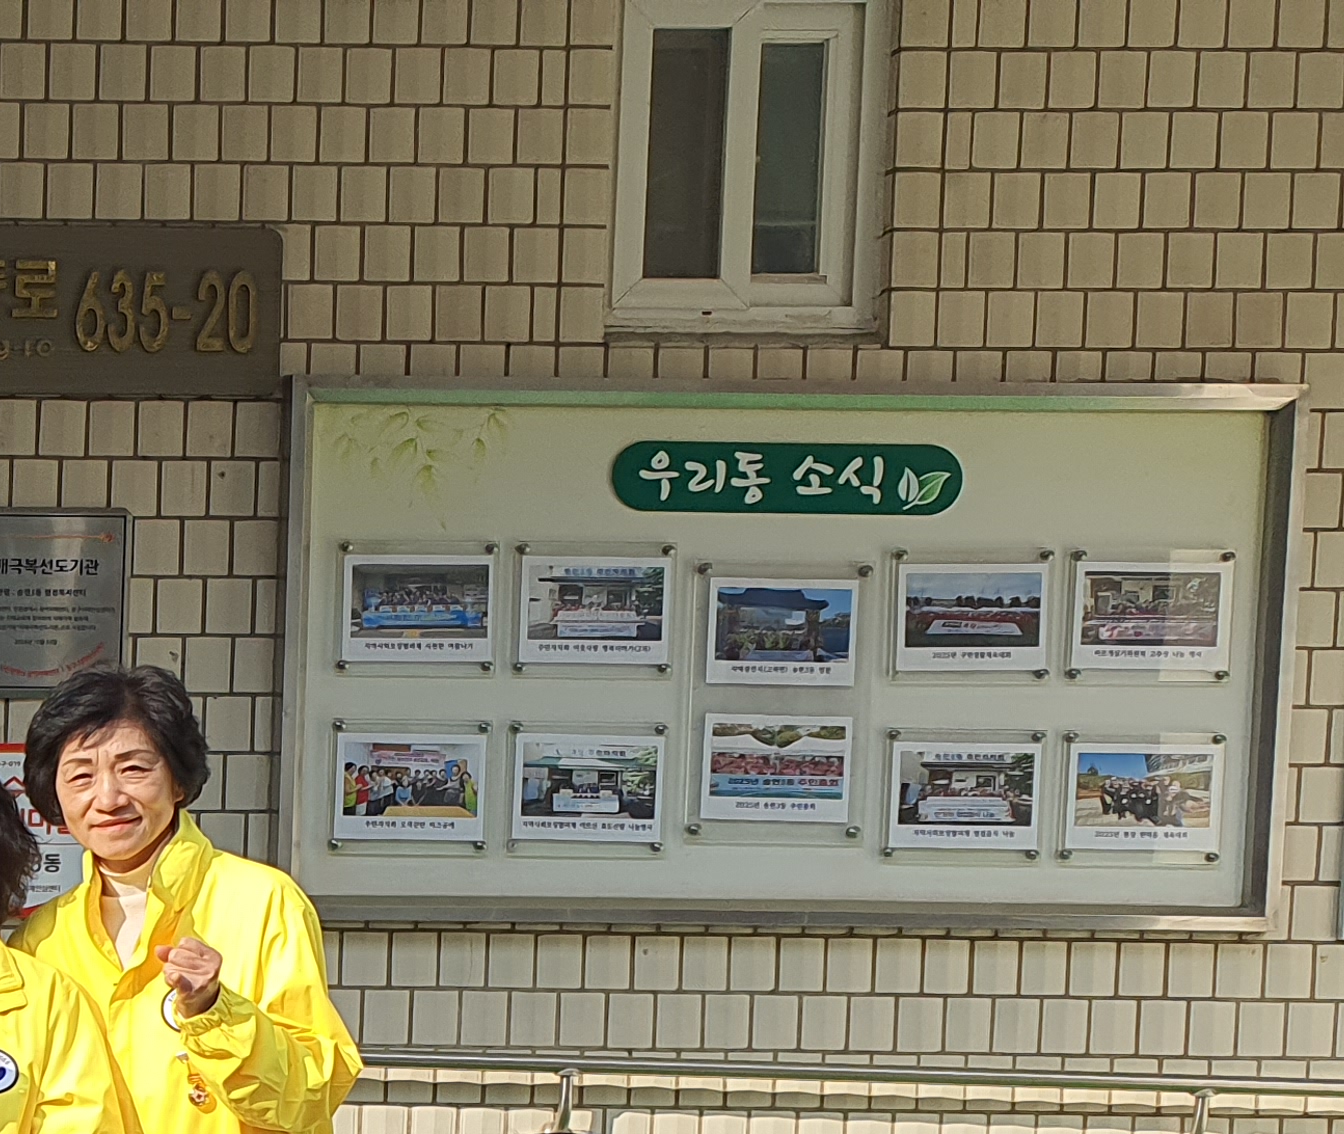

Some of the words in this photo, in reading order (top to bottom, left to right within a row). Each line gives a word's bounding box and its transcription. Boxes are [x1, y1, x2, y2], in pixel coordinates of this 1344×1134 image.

[75, 269, 257, 354] 635-20
[639, 450, 771, 504] 우리동
[792, 455, 885, 504] 소식
